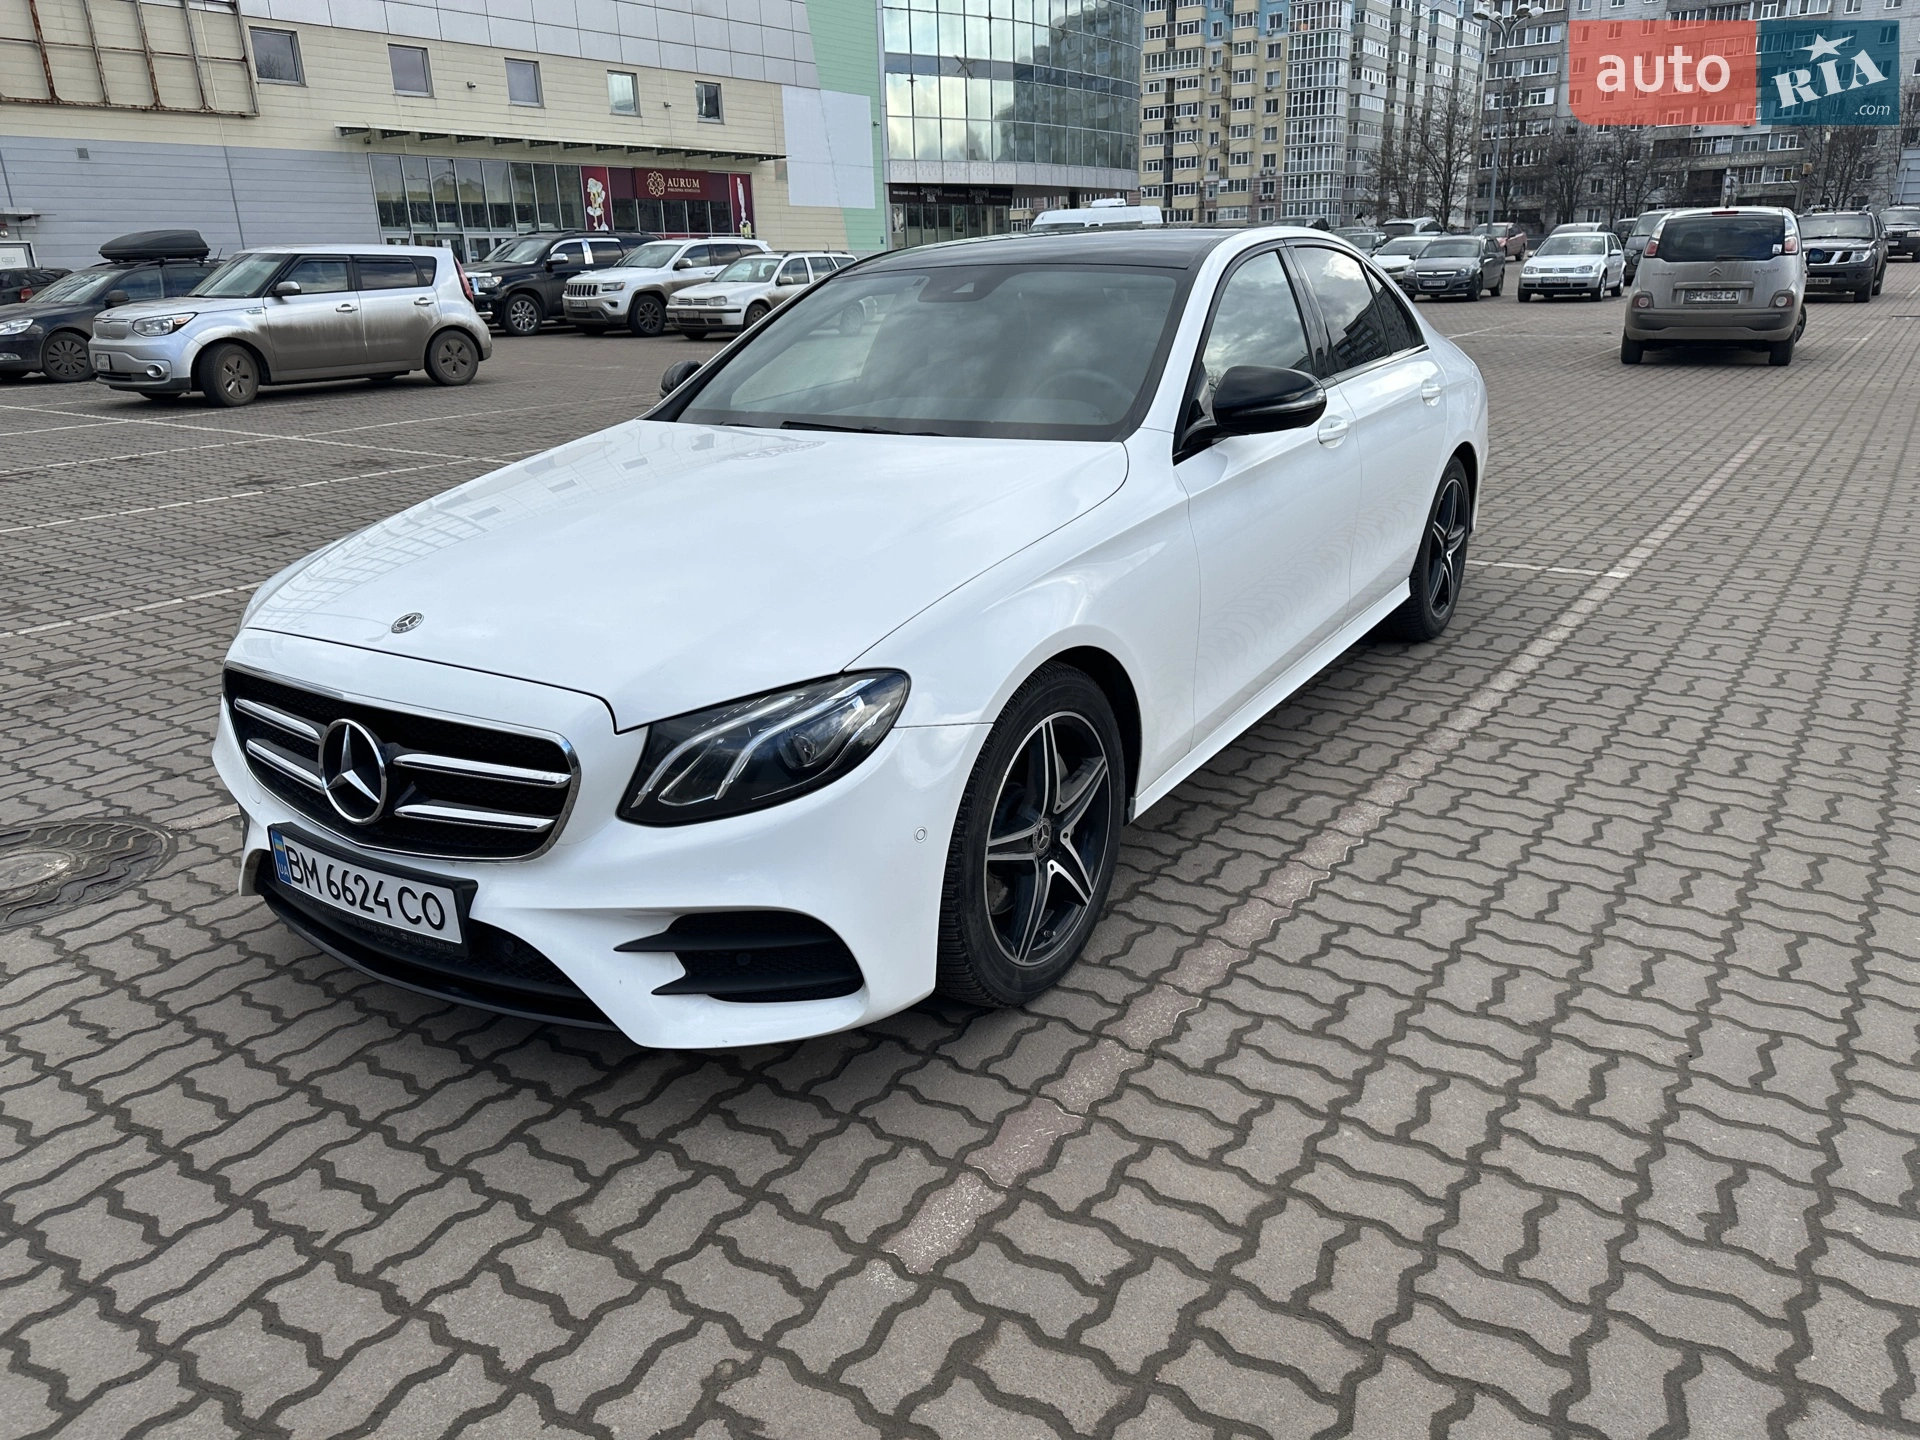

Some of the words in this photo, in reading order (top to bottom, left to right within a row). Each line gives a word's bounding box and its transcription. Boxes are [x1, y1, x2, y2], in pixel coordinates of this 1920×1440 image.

[667, 178, 700, 188] AURUM
[278, 863, 290, 877] UA
[285, 844, 322, 895] BM
[326, 863, 393, 919] 6624
[397, 886, 446, 931] CO
